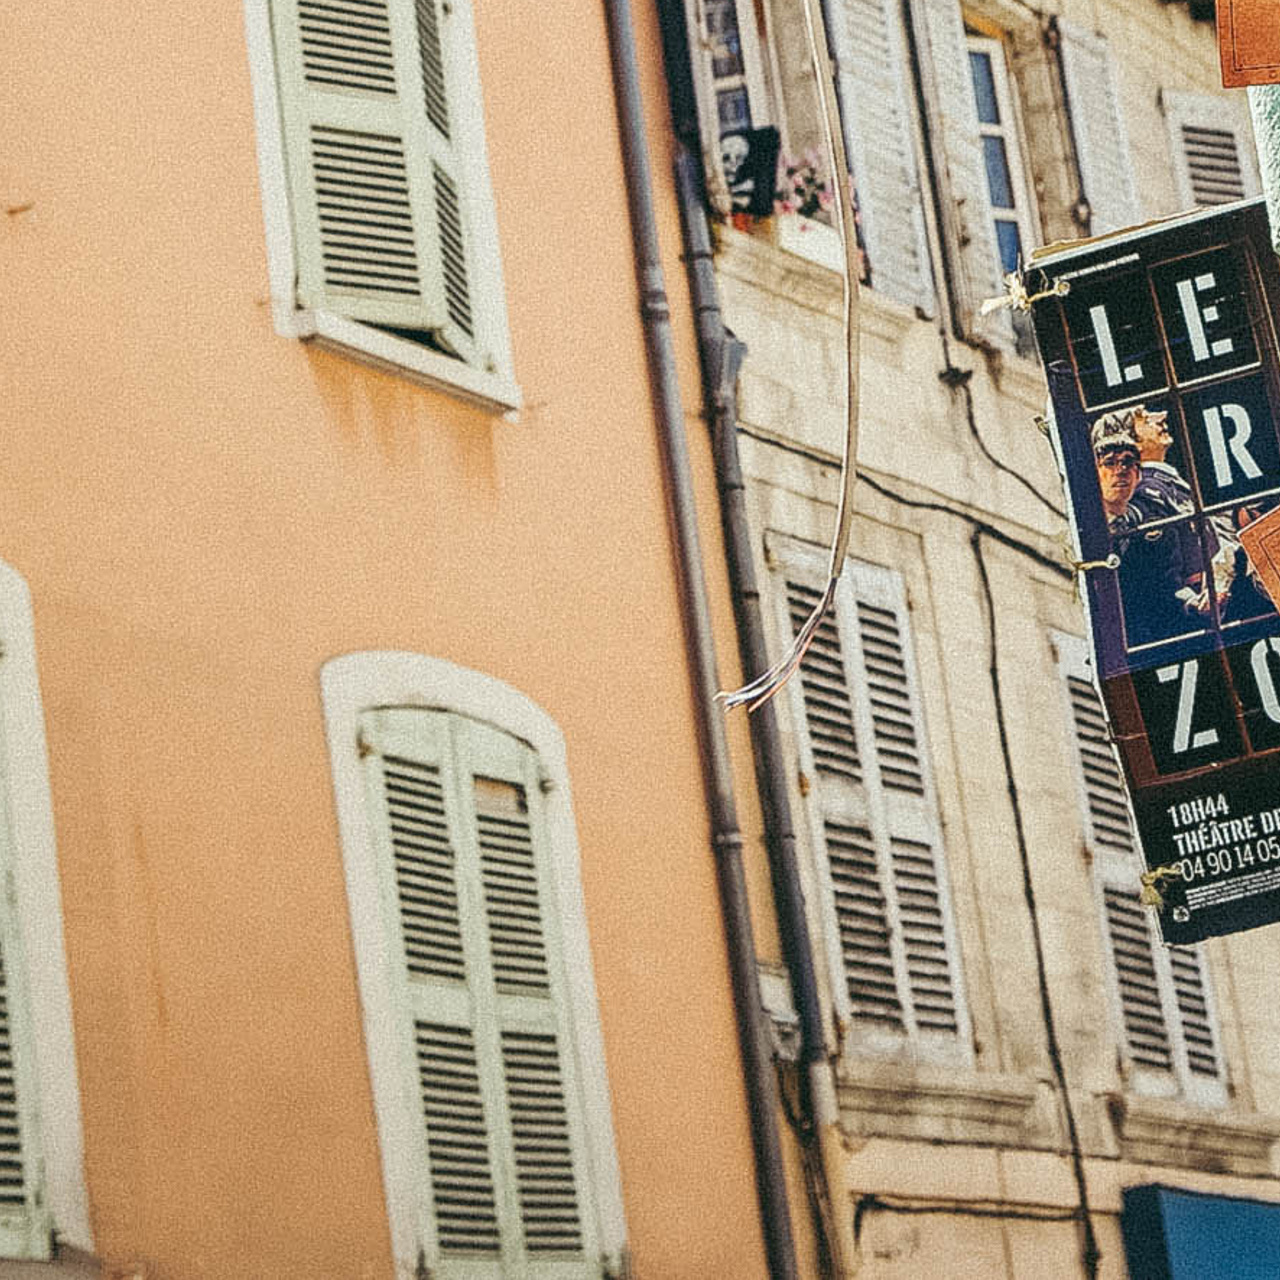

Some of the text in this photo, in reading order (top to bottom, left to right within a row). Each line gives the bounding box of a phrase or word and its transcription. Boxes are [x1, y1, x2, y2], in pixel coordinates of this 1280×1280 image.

[1201, 403, 1264, 490] R
[1167, 793, 1230, 828] 18H44
[1172, 815, 1258, 857] THÉÂTRE
[1180, 857, 1206, 882] 04
[1207, 849, 1232, 876] 90
[1235, 845, 1255, 870] 14
